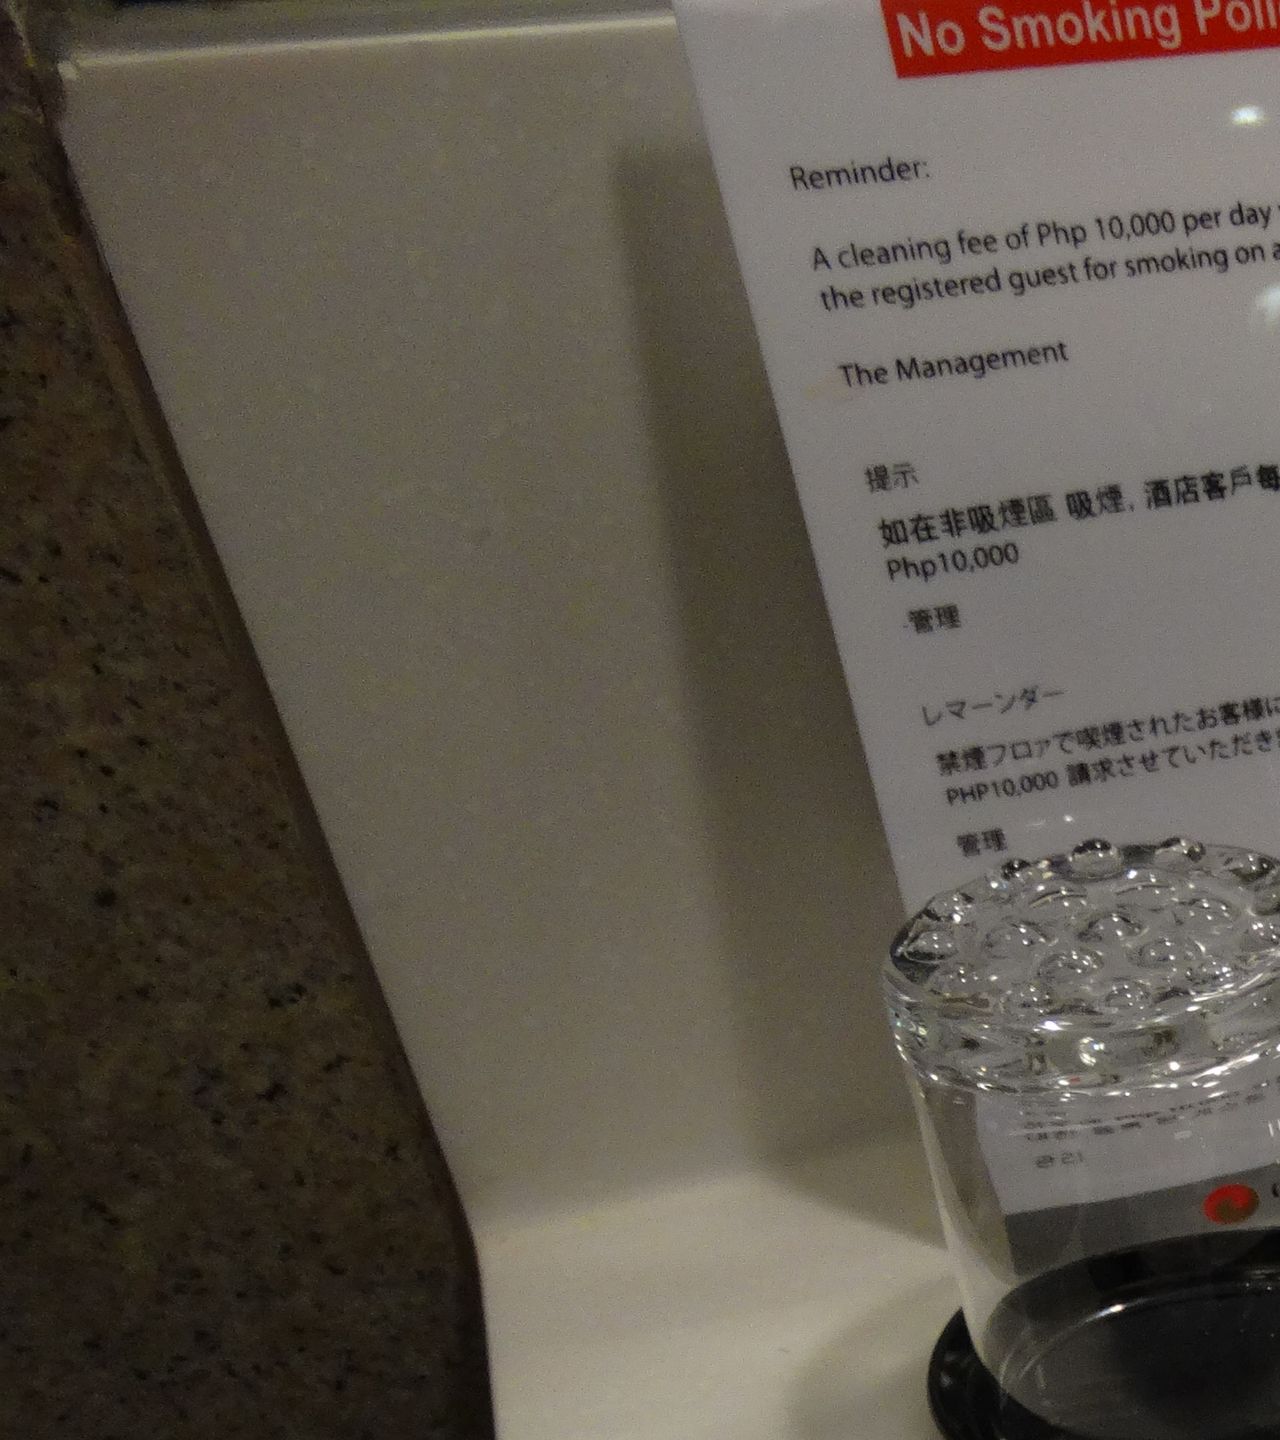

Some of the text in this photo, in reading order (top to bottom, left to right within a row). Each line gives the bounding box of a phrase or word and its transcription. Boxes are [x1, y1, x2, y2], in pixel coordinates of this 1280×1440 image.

[898, 12, 965, 58] No
[977, 0, 1183, 50] Smoking
[790, 157, 931, 191] Reminder:
[813, 247, 832, 271] A
[838, 236, 952, 269] cleaning
[957, 229, 998, 256] fee
[1005, 222, 1031, 251] of
[1036, 220, 1088, 249] Php
[1095, 209, 1176, 242] 10,000
[1182, 209, 1221, 237] per
[1229, 201, 1272, 229] day
[820, 286, 865, 312] the
[871, 266, 1003, 310] registered
[1008, 262, 1077, 296] guest
[1083, 256, 1118, 283] for
[1125, 242, 1230, 278] smoking
[1234, 243, 1267, 267] on
[839, 341, 1070, 389] The Management
[864, 462, 919, 493] 提示
[887, 542, 1020, 583] Php10,000
[907, 603, 962, 634] 管理
[946, 768, 1060, 806] PHP10,000
